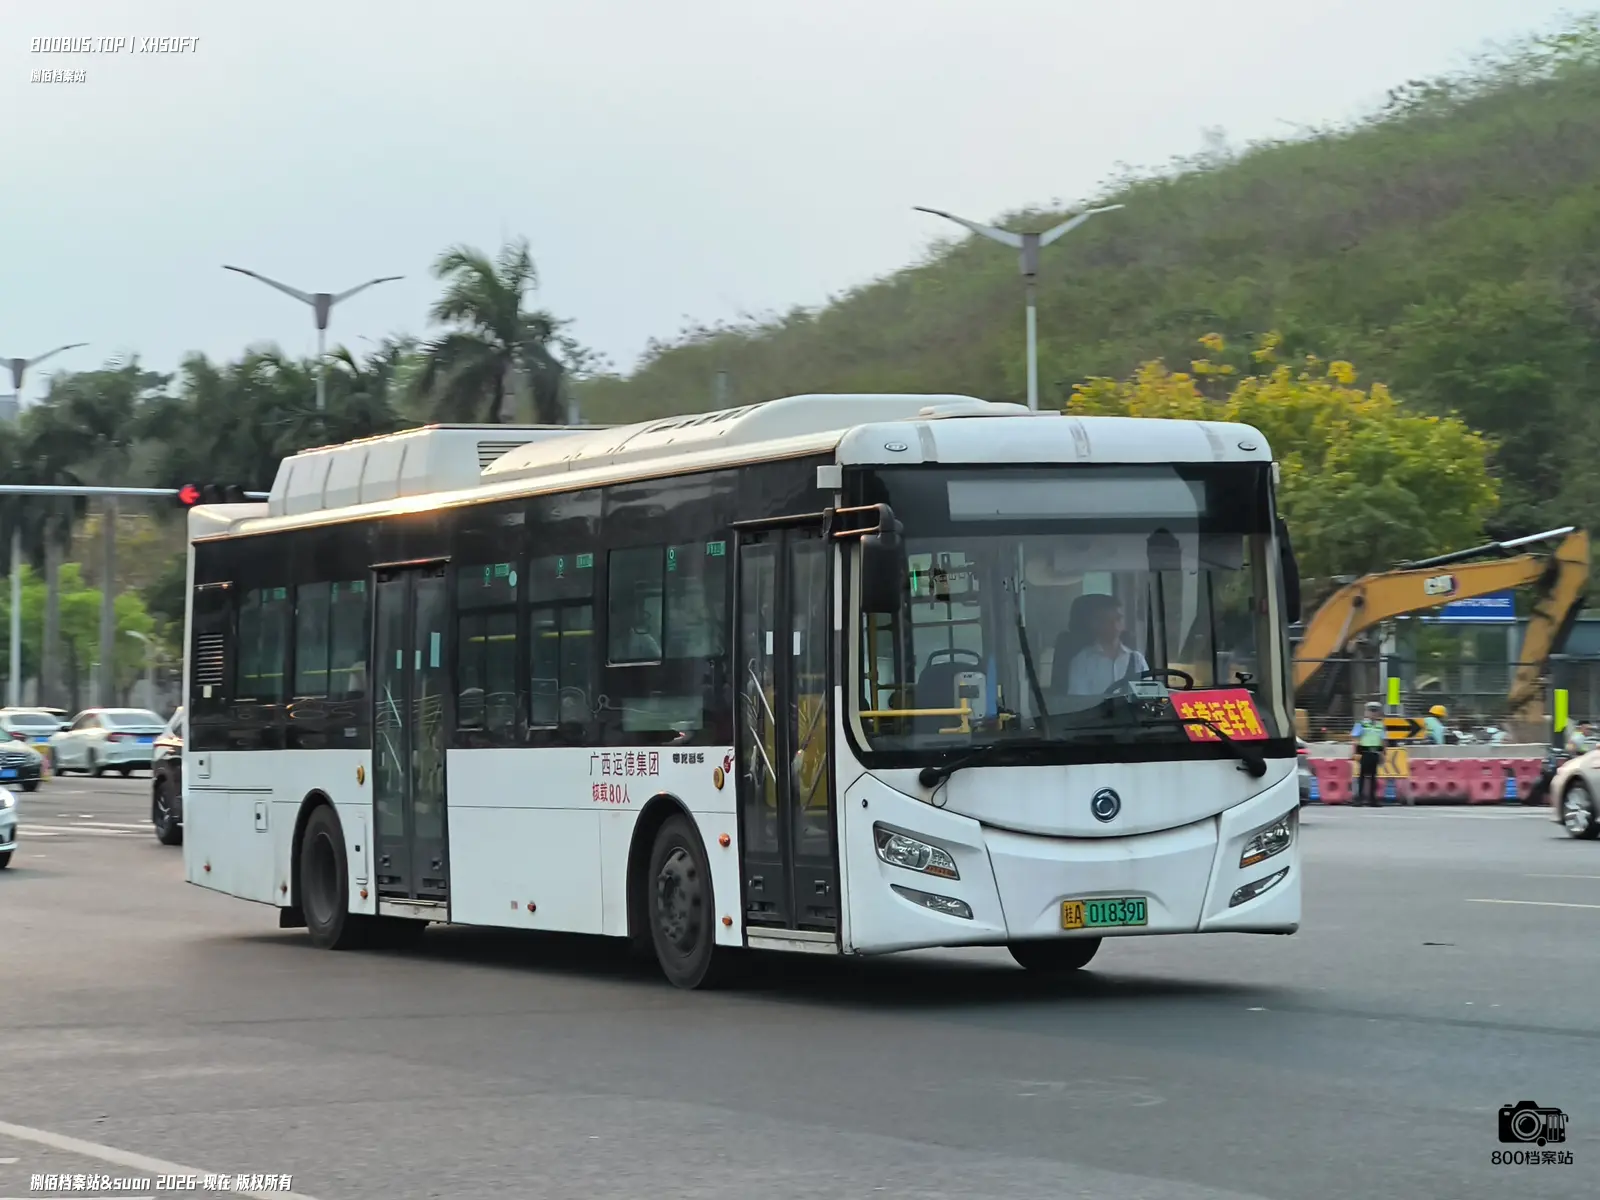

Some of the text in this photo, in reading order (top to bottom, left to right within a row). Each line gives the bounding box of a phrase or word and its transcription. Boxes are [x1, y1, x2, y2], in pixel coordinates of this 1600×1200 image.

[589, 751, 660, 777] 广西运德集团
[592, 782, 631, 804] 核载80人
